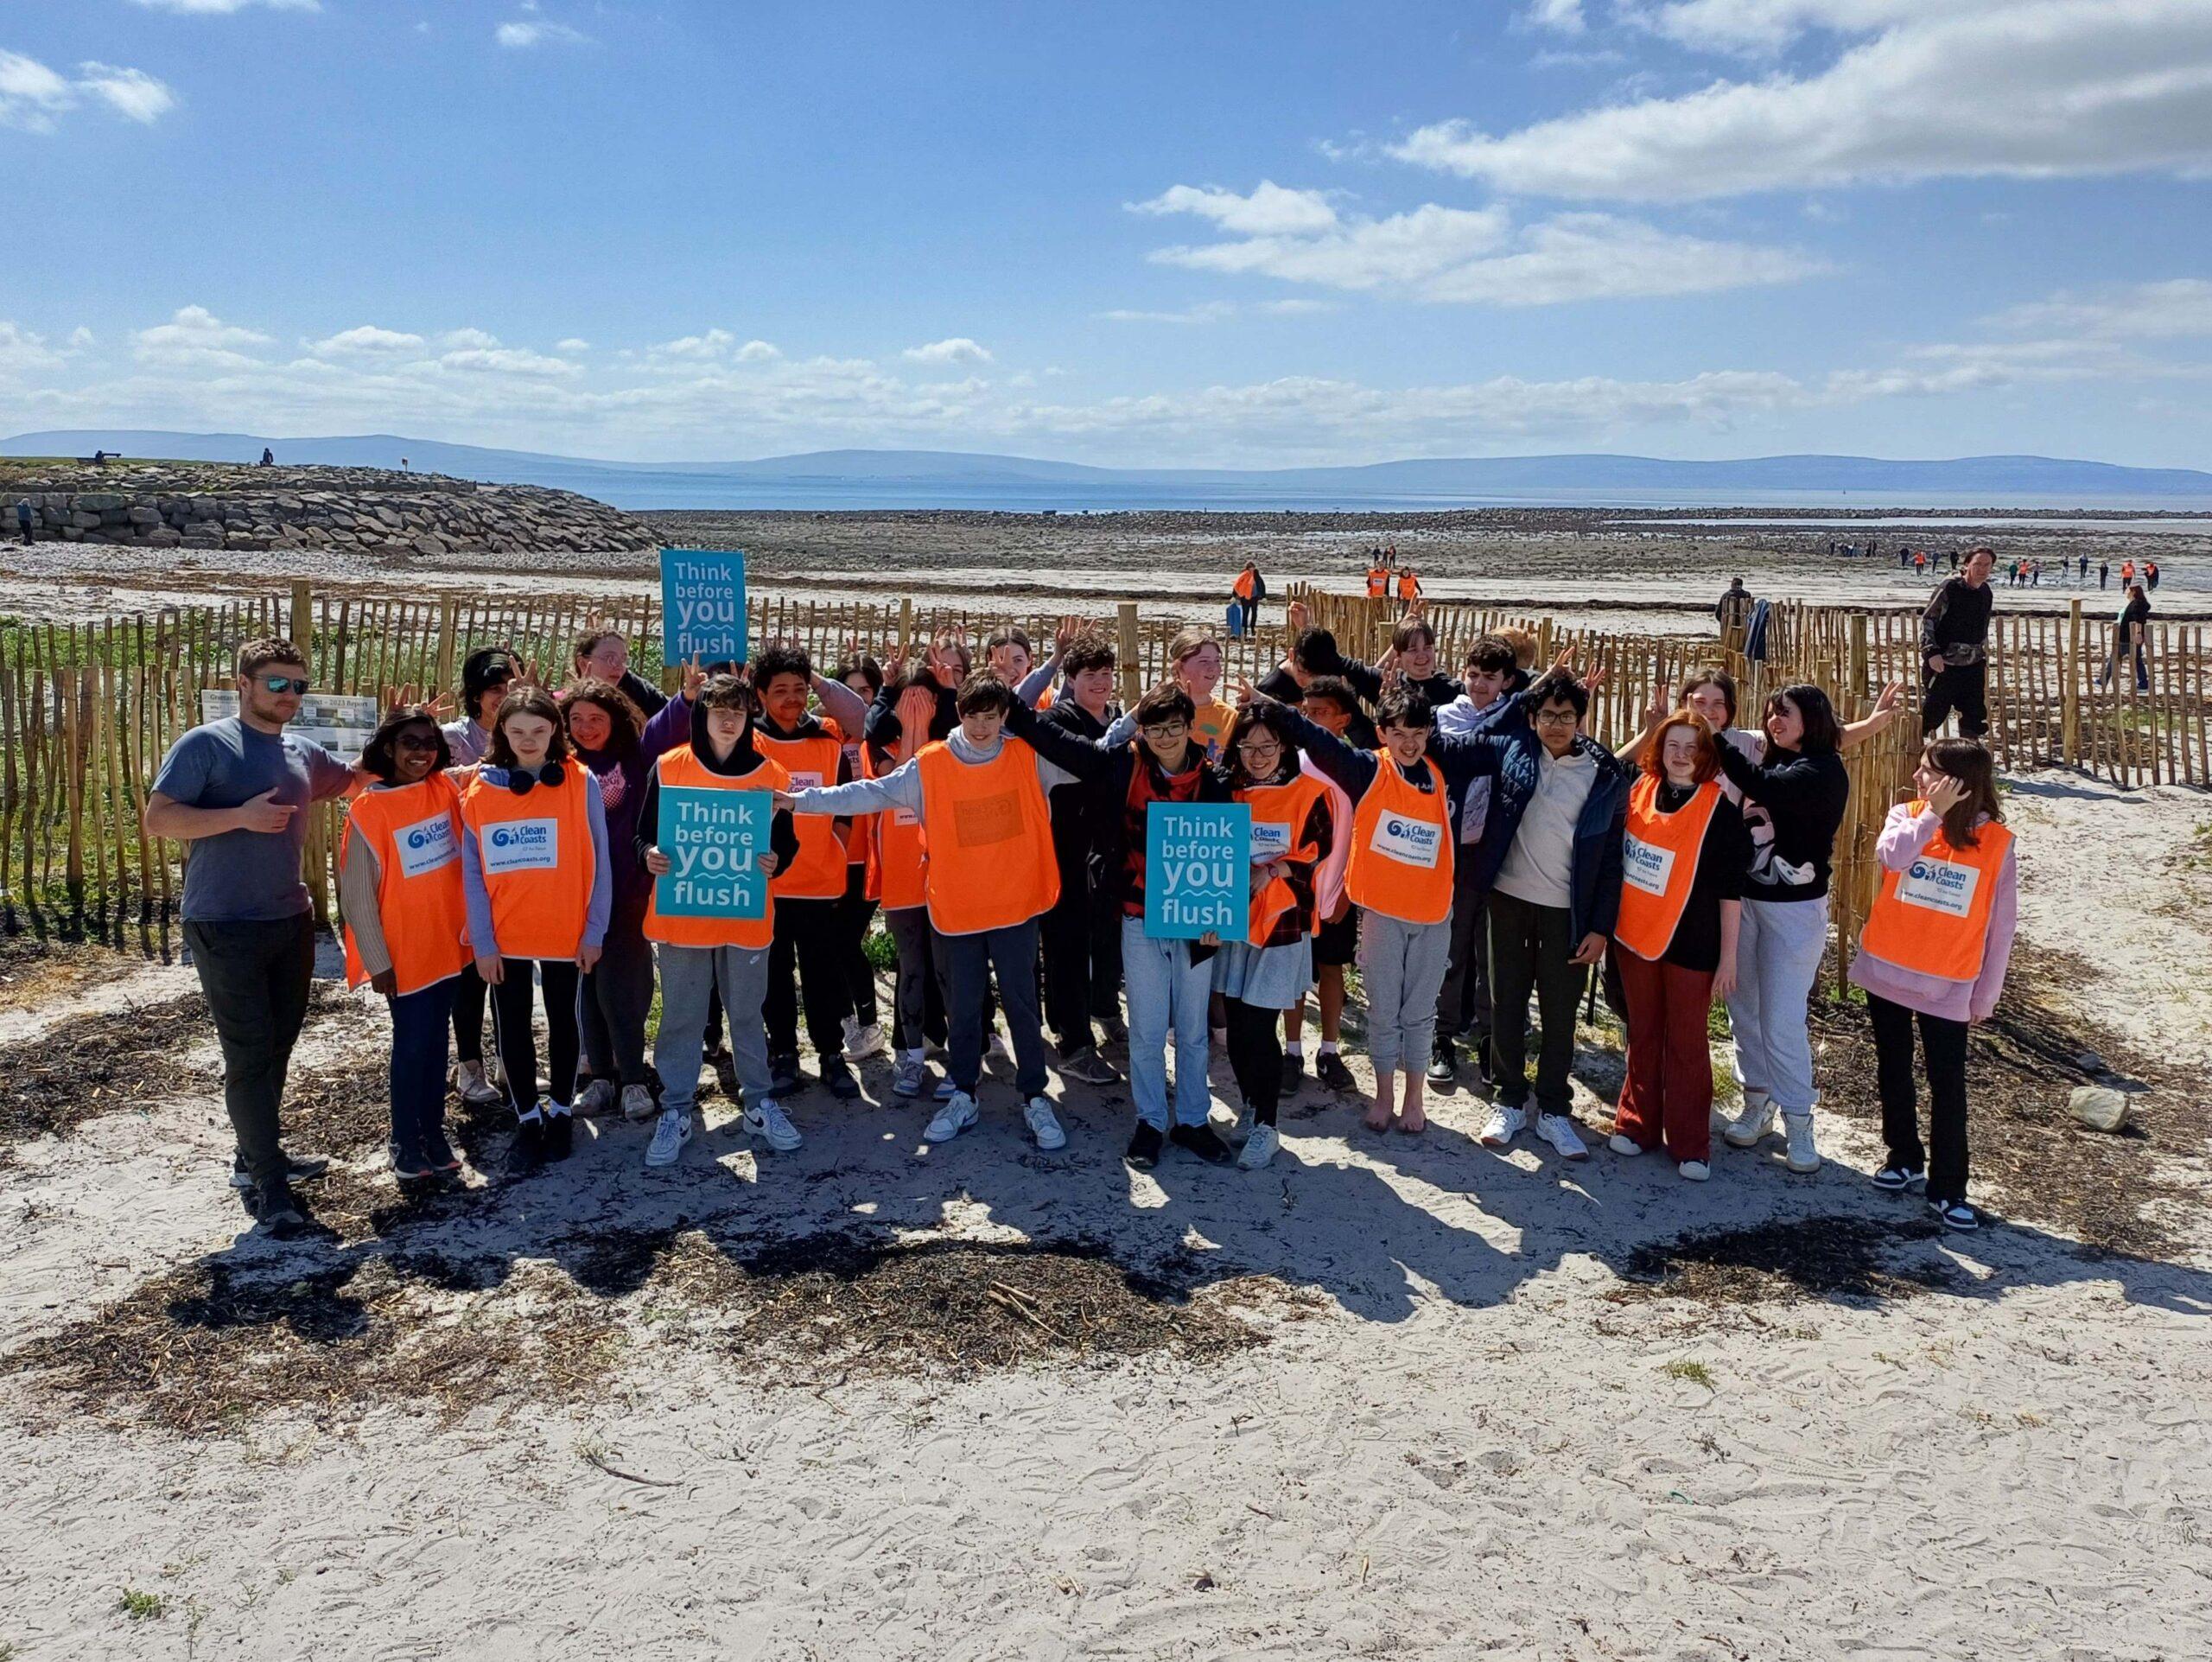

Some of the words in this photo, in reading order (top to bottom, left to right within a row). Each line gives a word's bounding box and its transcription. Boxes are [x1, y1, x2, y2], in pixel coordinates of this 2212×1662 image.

[674, 562, 732, 581] Think
[675, 582, 734, 599] before
[676, 601, 734, 630] you
[677, 633, 734, 654] flush
[677, 801, 753, 825] Think
[429, 819, 450, 833] Clean
[520, 825, 547, 836] Clean
[675, 825, 753, 845] before
[1163, 816, 1234, 837] Think
[1254, 826, 1281, 837] Clean
[1411, 825, 1435, 837] Clean
[520, 835, 547, 844] Coasts
[1409, 834, 1433, 845] Coasts
[1162, 839, 1234, 860] before
[1637, 847, 1662, 863] Clean
[675, 845, 753, 878] you
[1635, 856, 1660, 871] Coasts
[1162, 861, 1234, 895] you
[1936, 876, 1964, 890] Coasts
[1938, 866, 1967, 882] Clean
[674, 881, 750, 907] flush
[1161, 898, 1232, 926] flush
